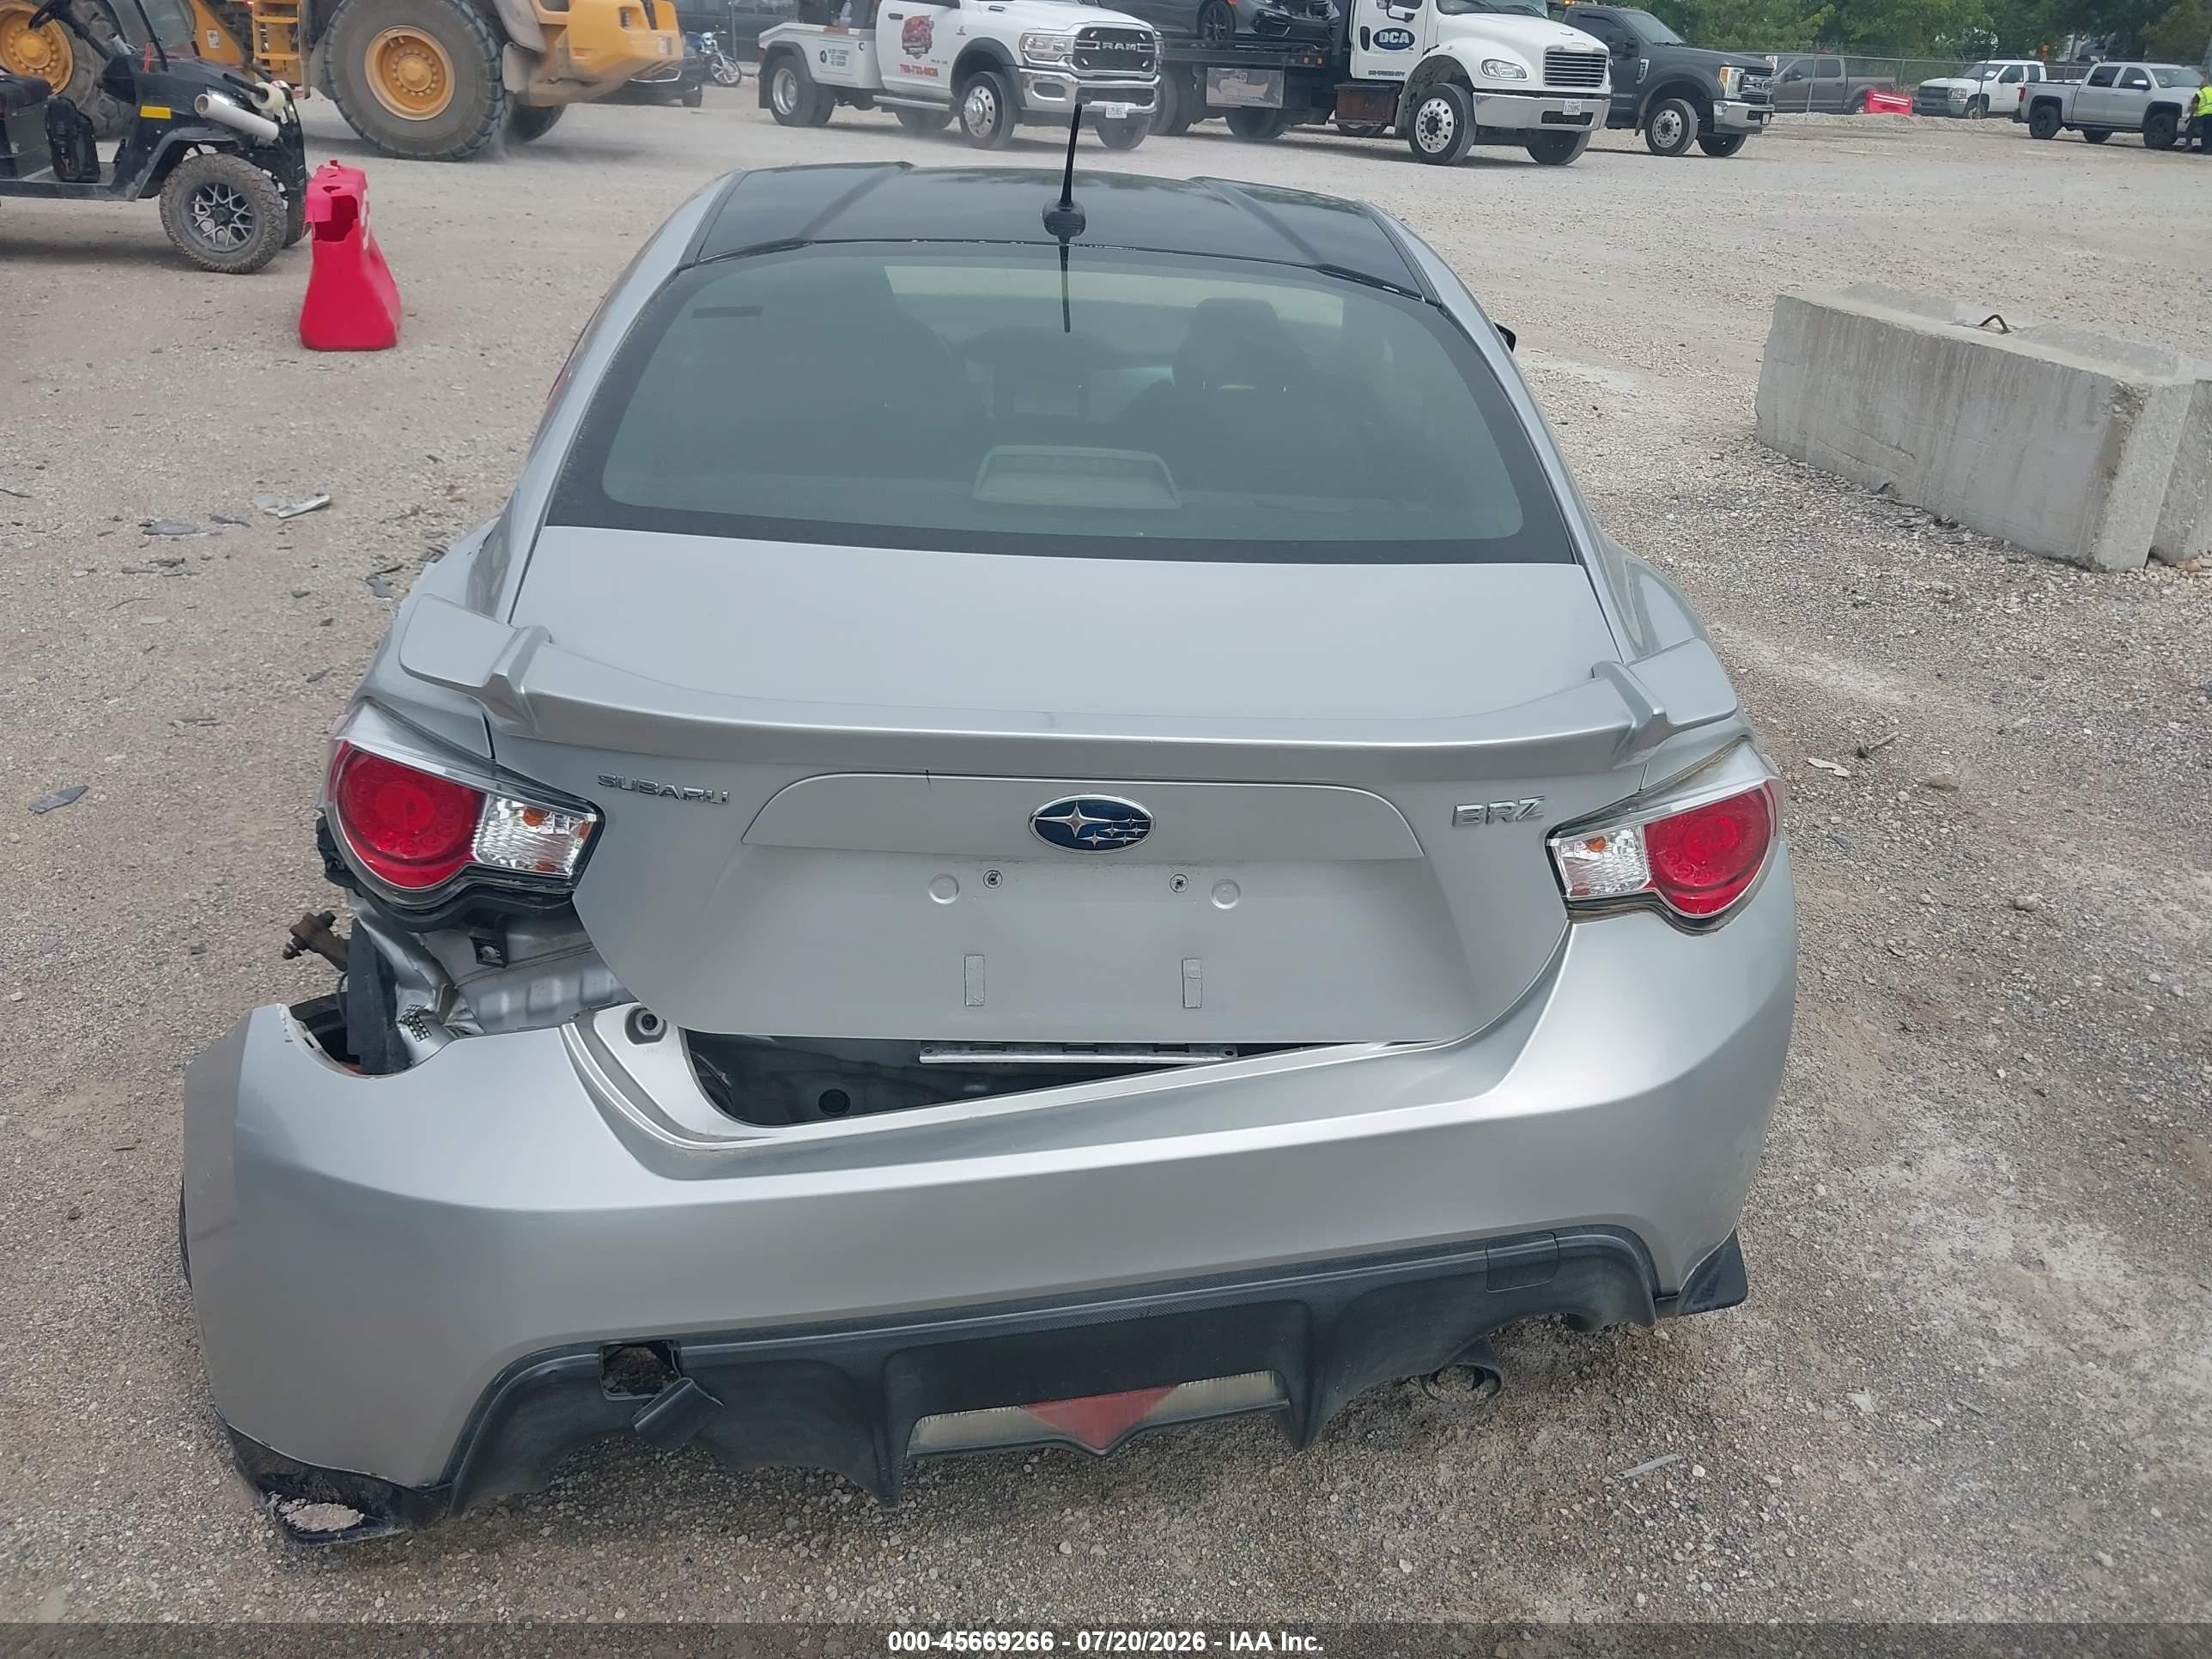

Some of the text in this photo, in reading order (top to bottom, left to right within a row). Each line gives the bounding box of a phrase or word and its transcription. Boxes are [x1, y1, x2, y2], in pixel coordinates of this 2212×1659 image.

[1102, 42, 1137, 51] RAM
[1378, 31, 1410, 44] DCA
[598, 772, 730, 805] SUBARU
[1451, 795, 1546, 827] BRZ
